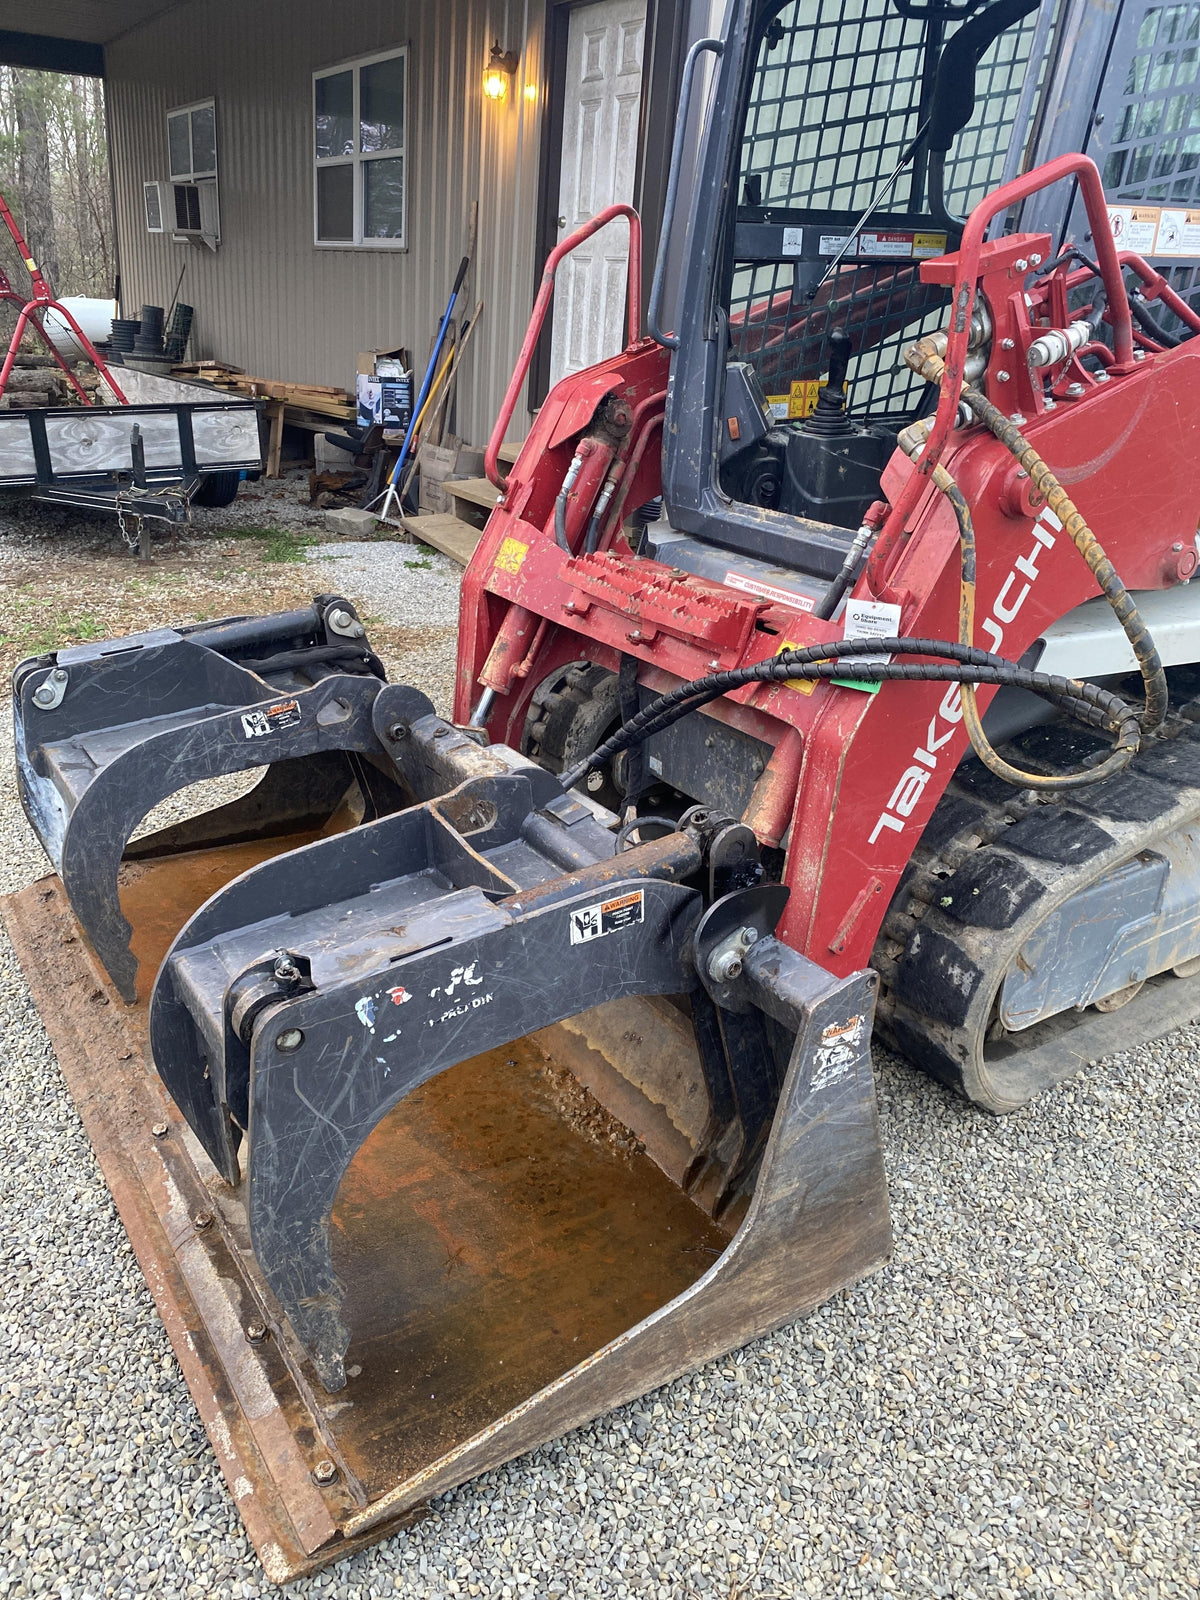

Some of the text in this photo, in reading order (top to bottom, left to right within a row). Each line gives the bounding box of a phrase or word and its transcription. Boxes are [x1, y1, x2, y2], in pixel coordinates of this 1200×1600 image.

[744, 582, 812, 609] CUSTOMER RESPONSIBILITY
[860, 613, 892, 623] Equipment
